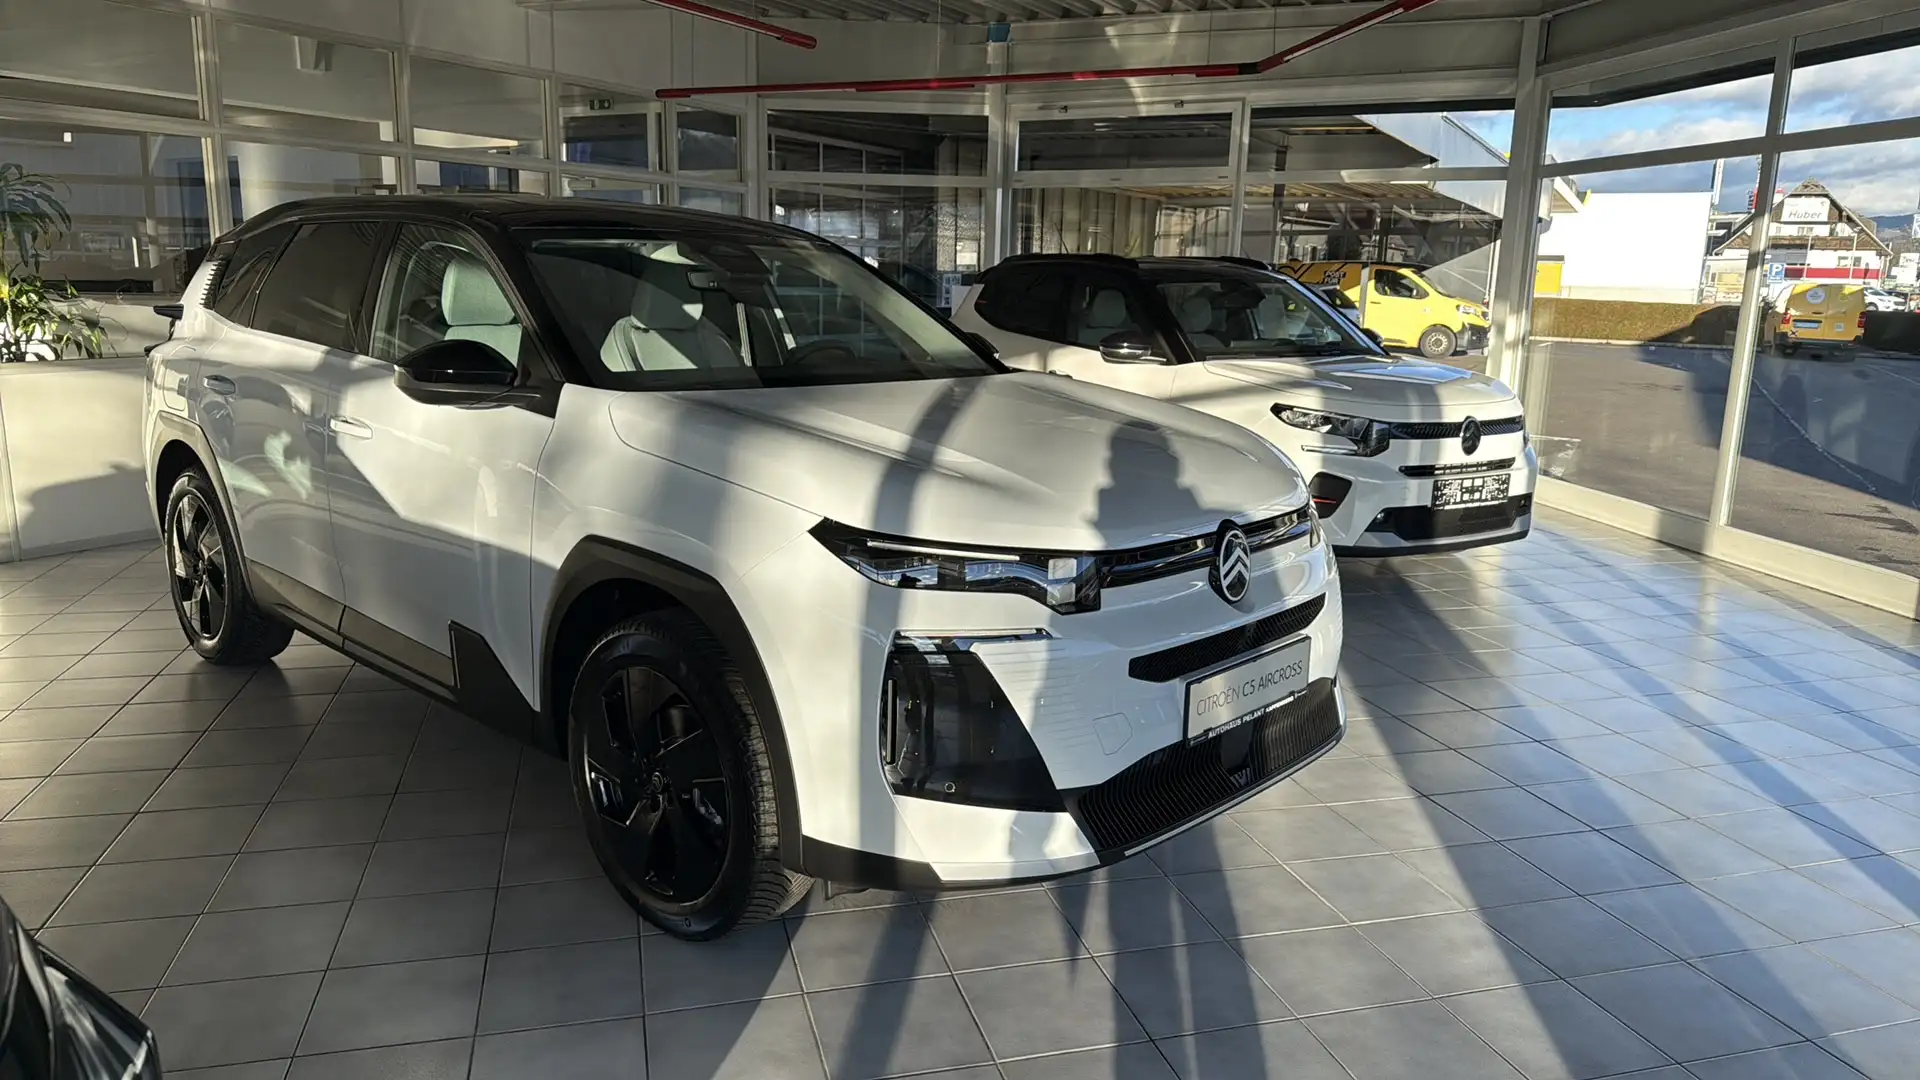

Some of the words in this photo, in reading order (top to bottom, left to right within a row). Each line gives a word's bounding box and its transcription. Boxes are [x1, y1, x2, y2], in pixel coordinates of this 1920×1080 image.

[1788, 210, 1823, 219] Huber
[1772, 264, 1783, 275] P
[1196, 685, 1240, 716] CITROËN
[1242, 679, 1256, 697] C5
[1257, 660, 1303, 691] AIRCROSS
[1207, 718, 1242, 739] AUTOHAUS
[1242, 708, 1265, 723] PELANT
